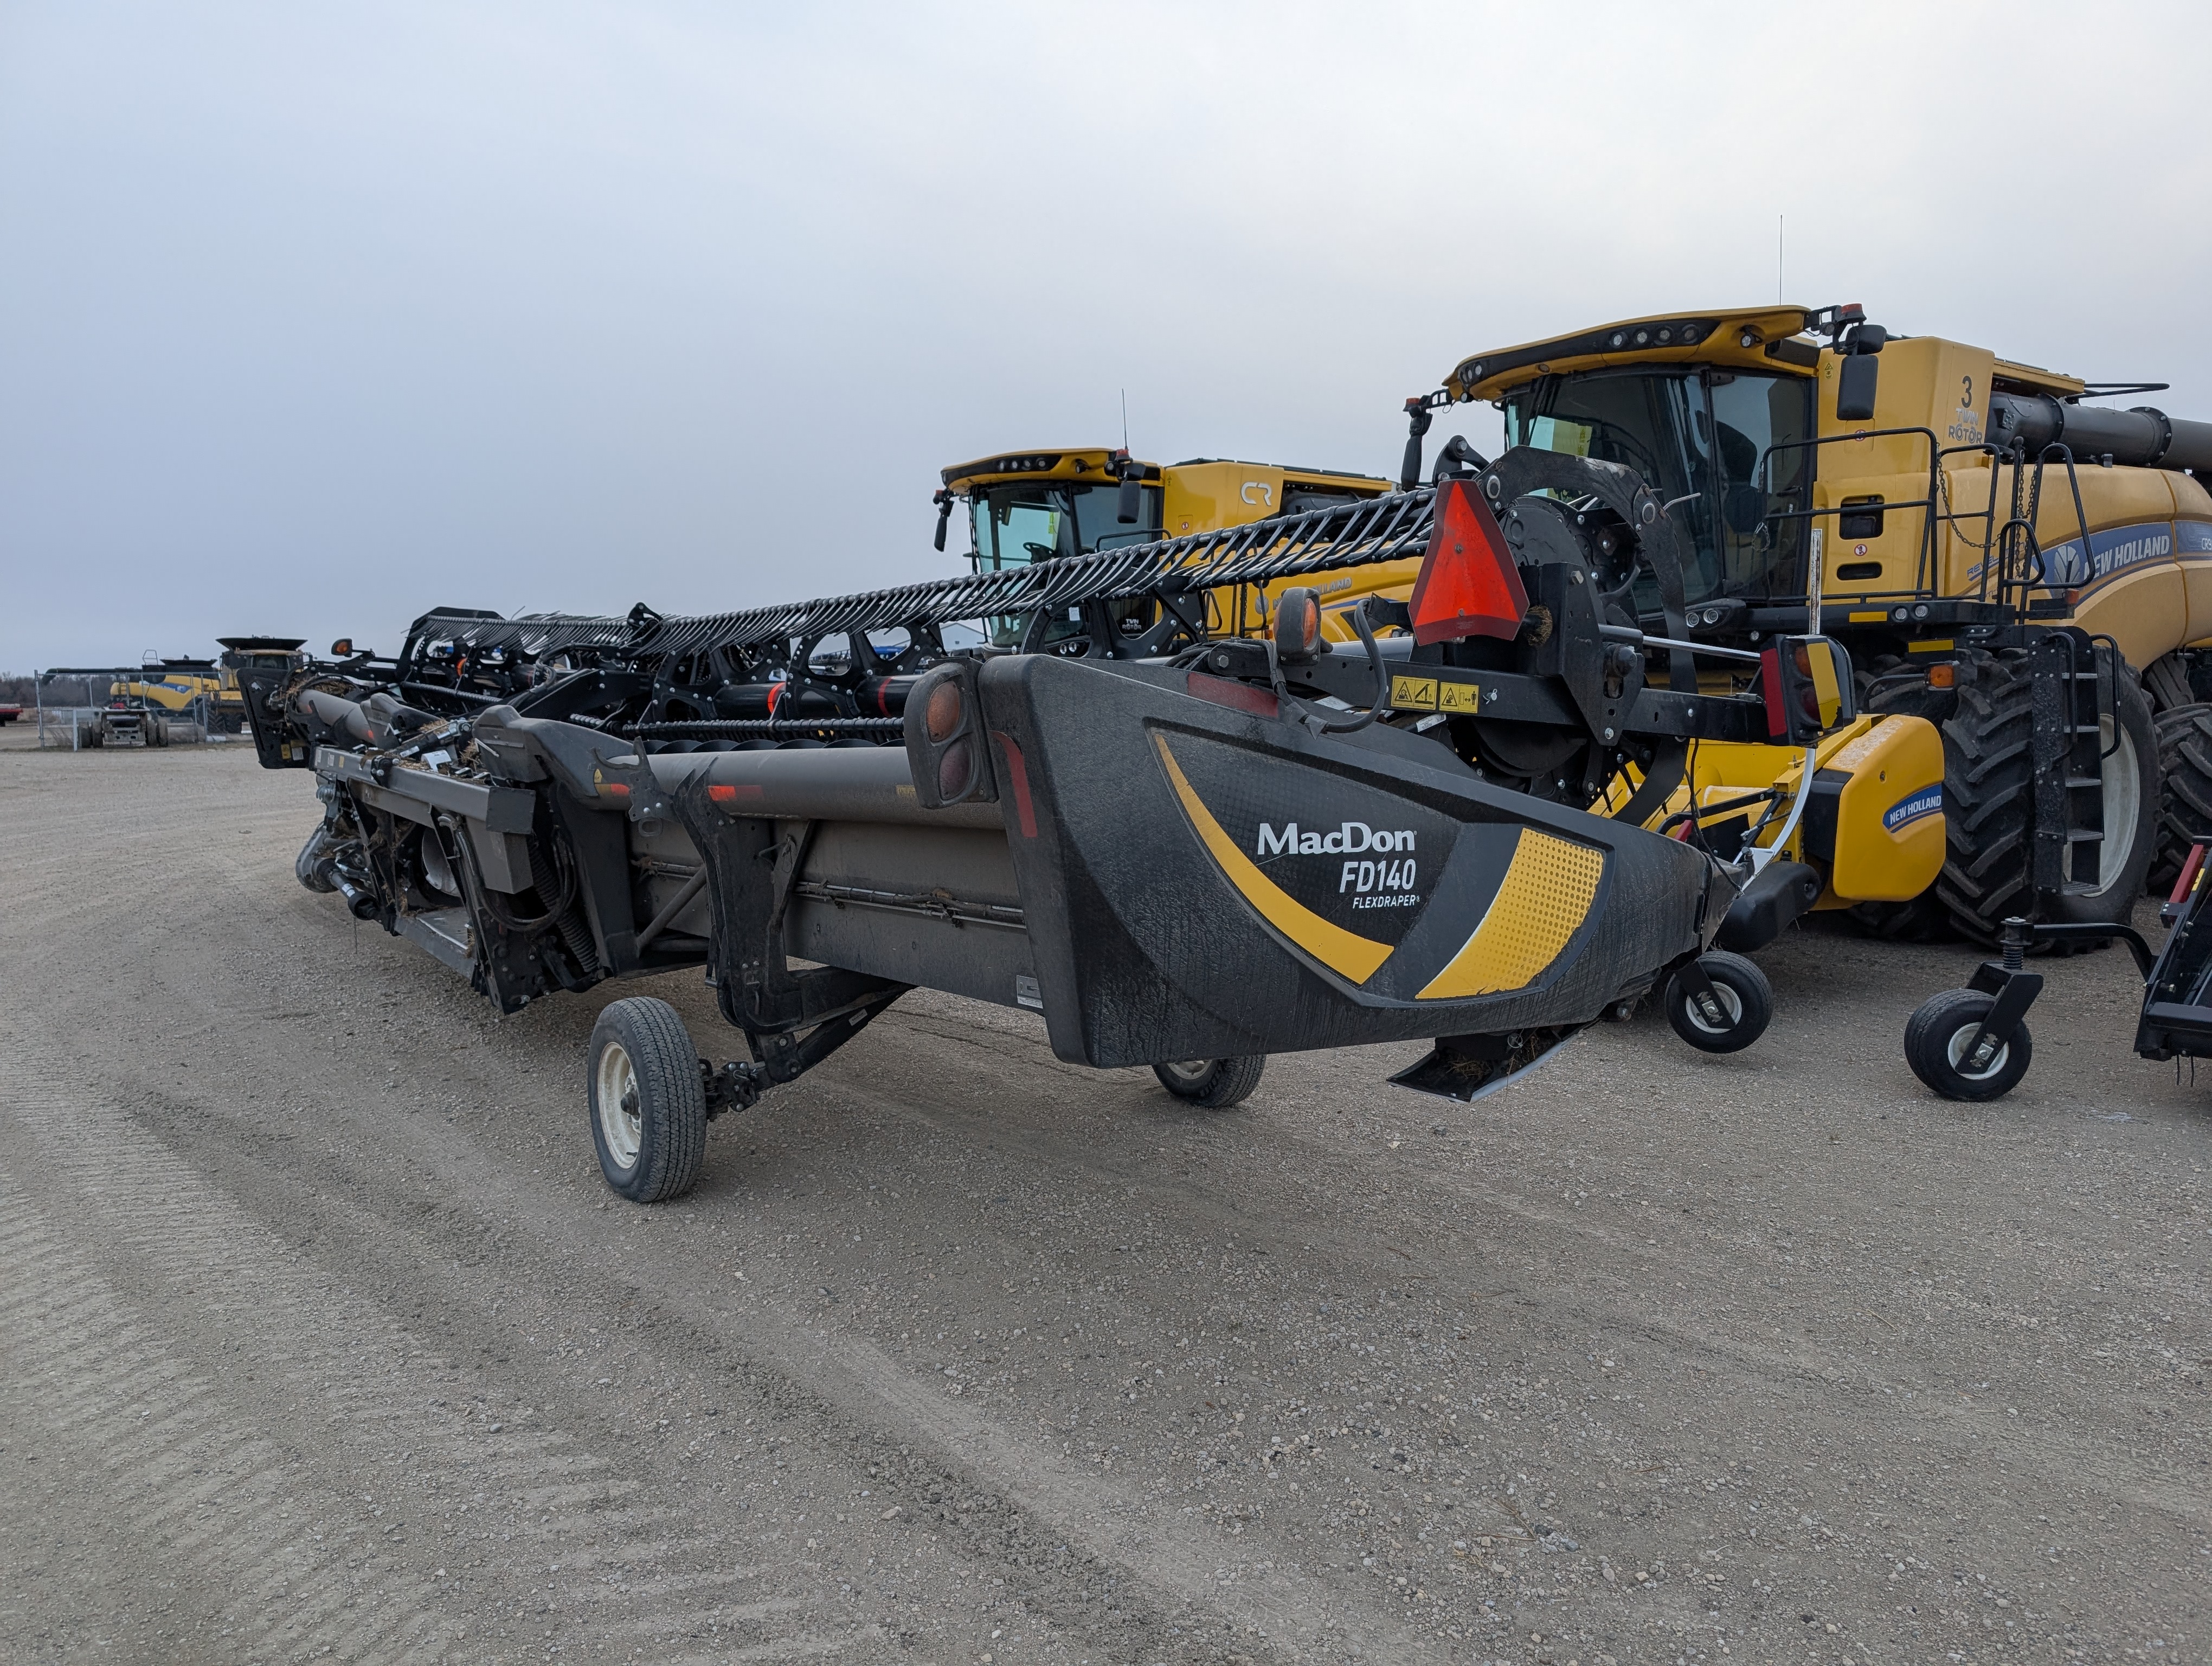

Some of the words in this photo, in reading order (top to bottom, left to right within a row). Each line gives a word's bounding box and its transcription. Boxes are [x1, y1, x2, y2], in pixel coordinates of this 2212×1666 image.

[1961, 375, 1972, 408] 3
[1956, 407, 1978, 426] TWIN
[1949, 422, 1982, 444] ROTOR
[2114, 535, 2169, 569] HOLLAND
[1889, 805, 1907, 825] NEW
[1907, 795, 1941, 816] HOLLAND
[1339, 858, 1416, 893] FD140
